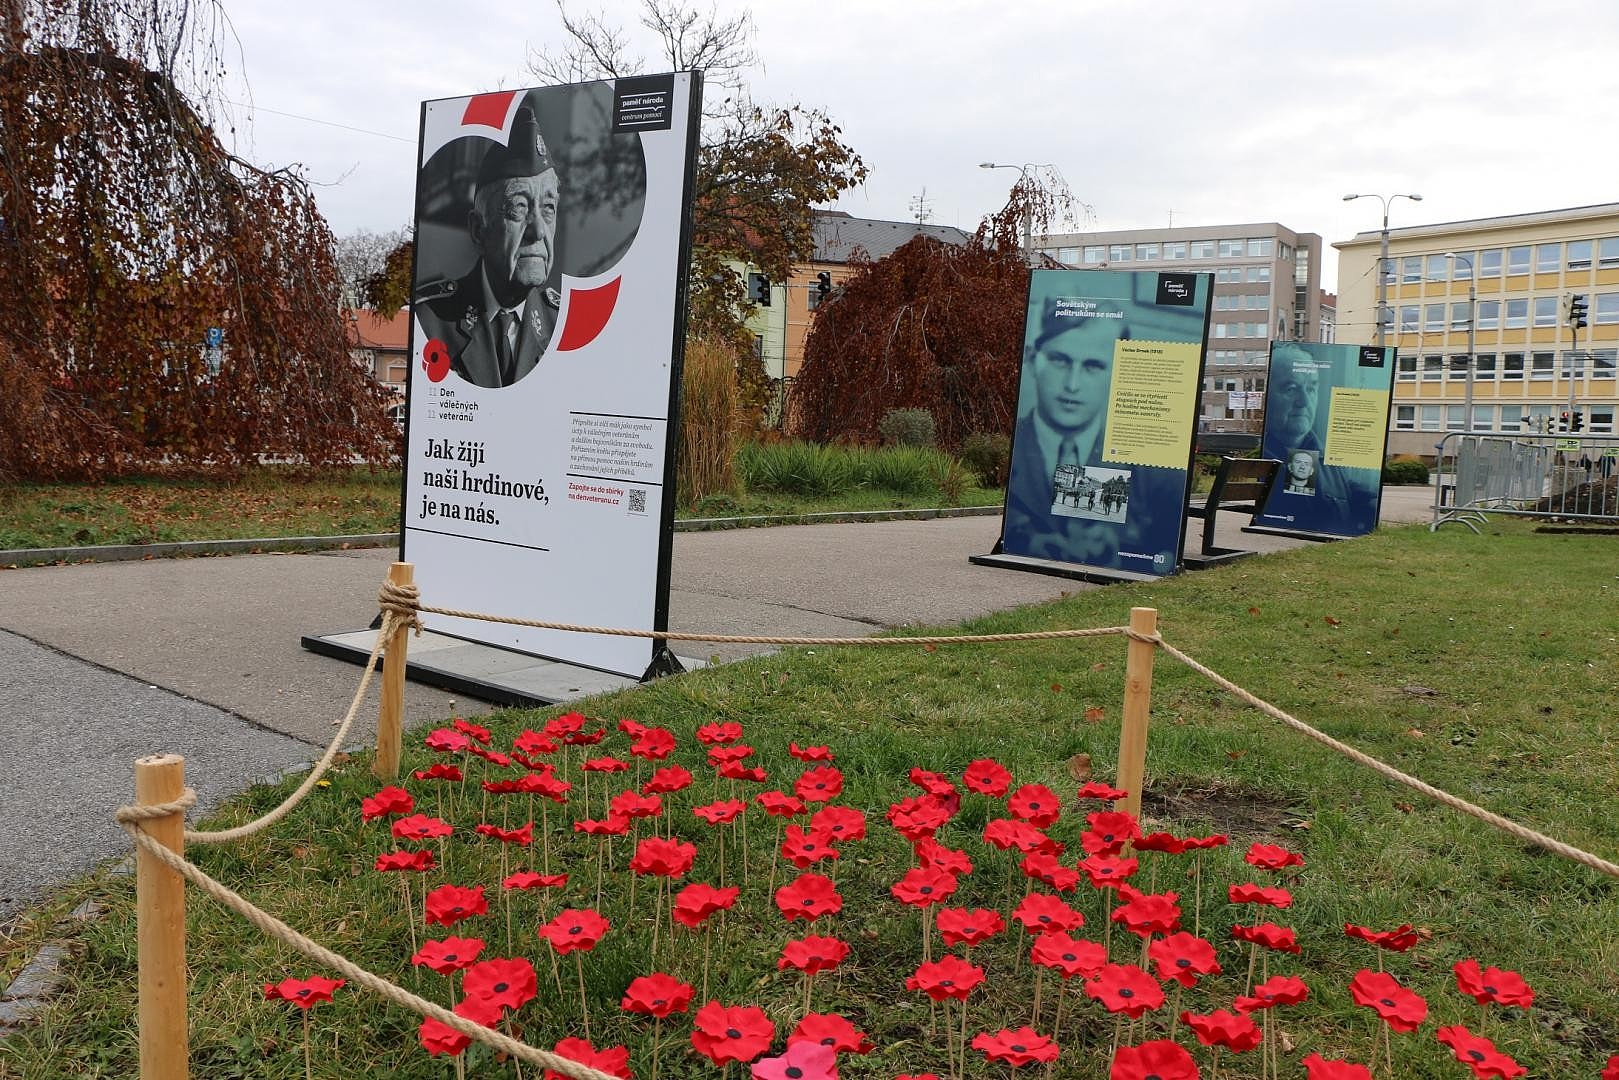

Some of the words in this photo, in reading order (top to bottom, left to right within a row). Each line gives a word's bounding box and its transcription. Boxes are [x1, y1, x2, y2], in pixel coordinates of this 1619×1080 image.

[622, 98, 642, 107] paměť
[642, 96, 664, 104] národa
[1056, 300, 1096, 310] Sovětským
[1055, 309, 1096, 318] politrukům
[440, 388, 455, 397] Den
[440, 400, 479, 412] válečných
[439, 412, 474, 421] veteránů
[425, 439, 454, 460] Jak
[458, 440, 485, 468] žijí
[424, 468, 458, 490] naši
[462, 470, 549, 506] hrdinové,
[568, 482, 590, 491] Zapojte
[605, 487, 624, 497] sbírky
[575, 493, 619, 505] denveteranu.cz
[420, 495, 436, 518] je
[440, 502, 460, 519] na
[464, 502, 500, 525] nás.
[1154, 554, 1165, 564] 80
